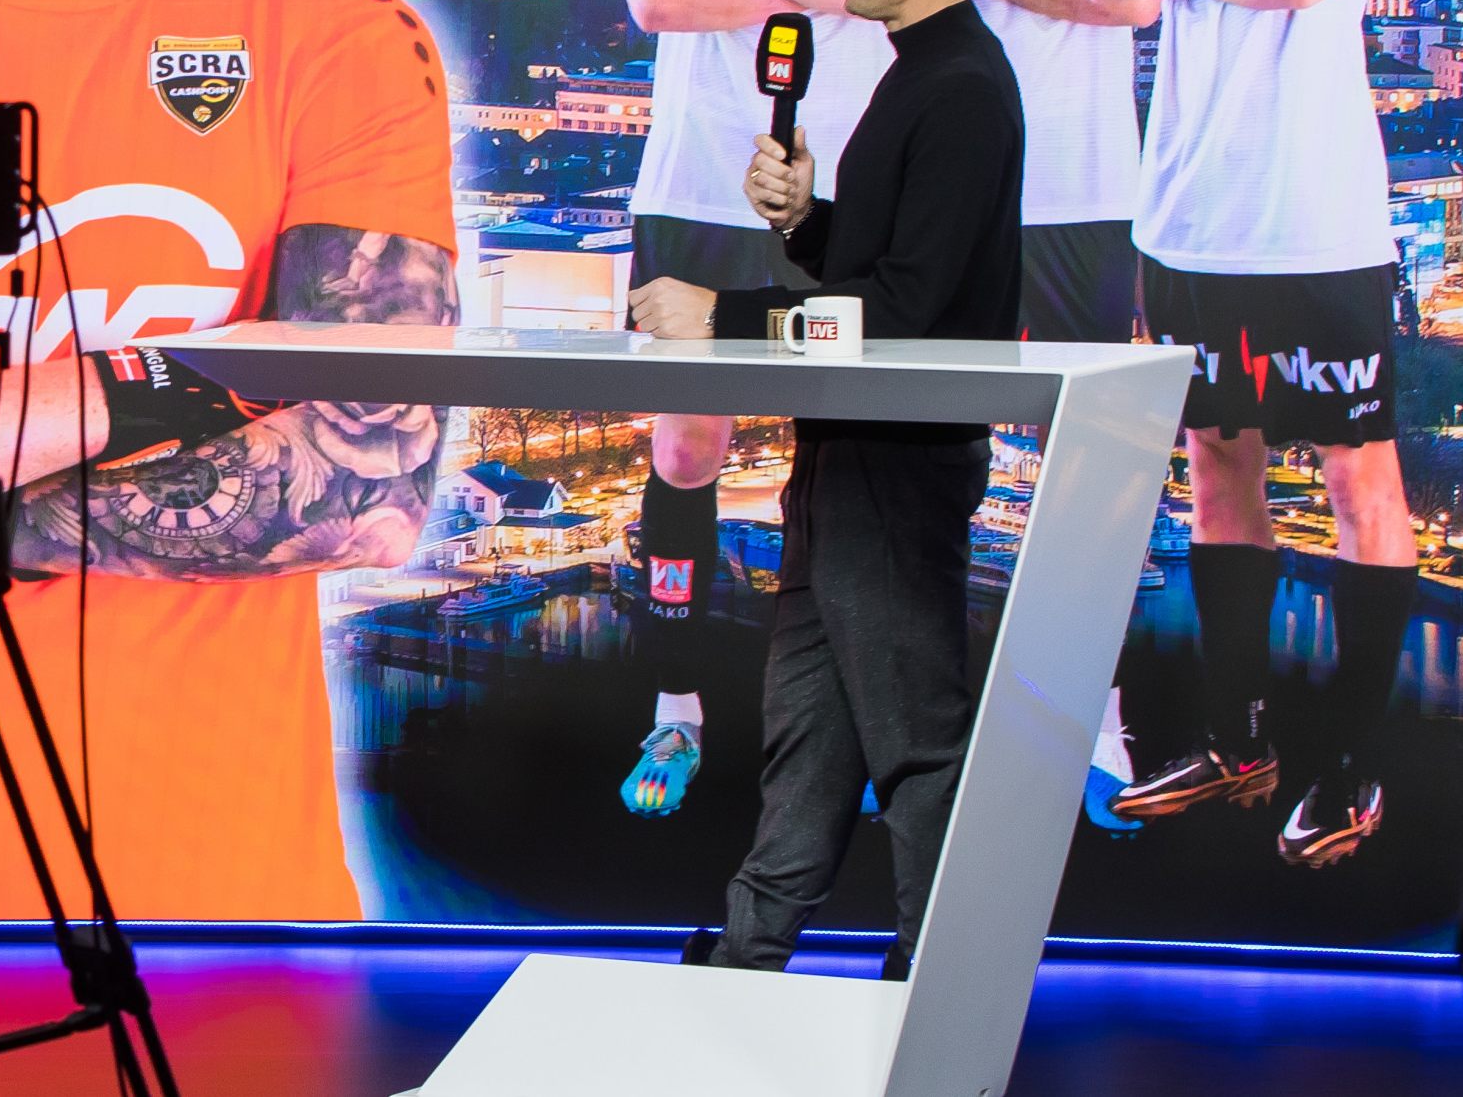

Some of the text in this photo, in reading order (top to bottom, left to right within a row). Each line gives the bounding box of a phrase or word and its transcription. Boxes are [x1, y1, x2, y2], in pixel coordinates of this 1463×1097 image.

[156, 53, 246, 78] SCRA
[807, 322, 837, 339] LIVE
[138, 347, 172, 390] NGDAL
[1271, 346, 1381, 394] vkw
[650, 561, 690, 591] VN
